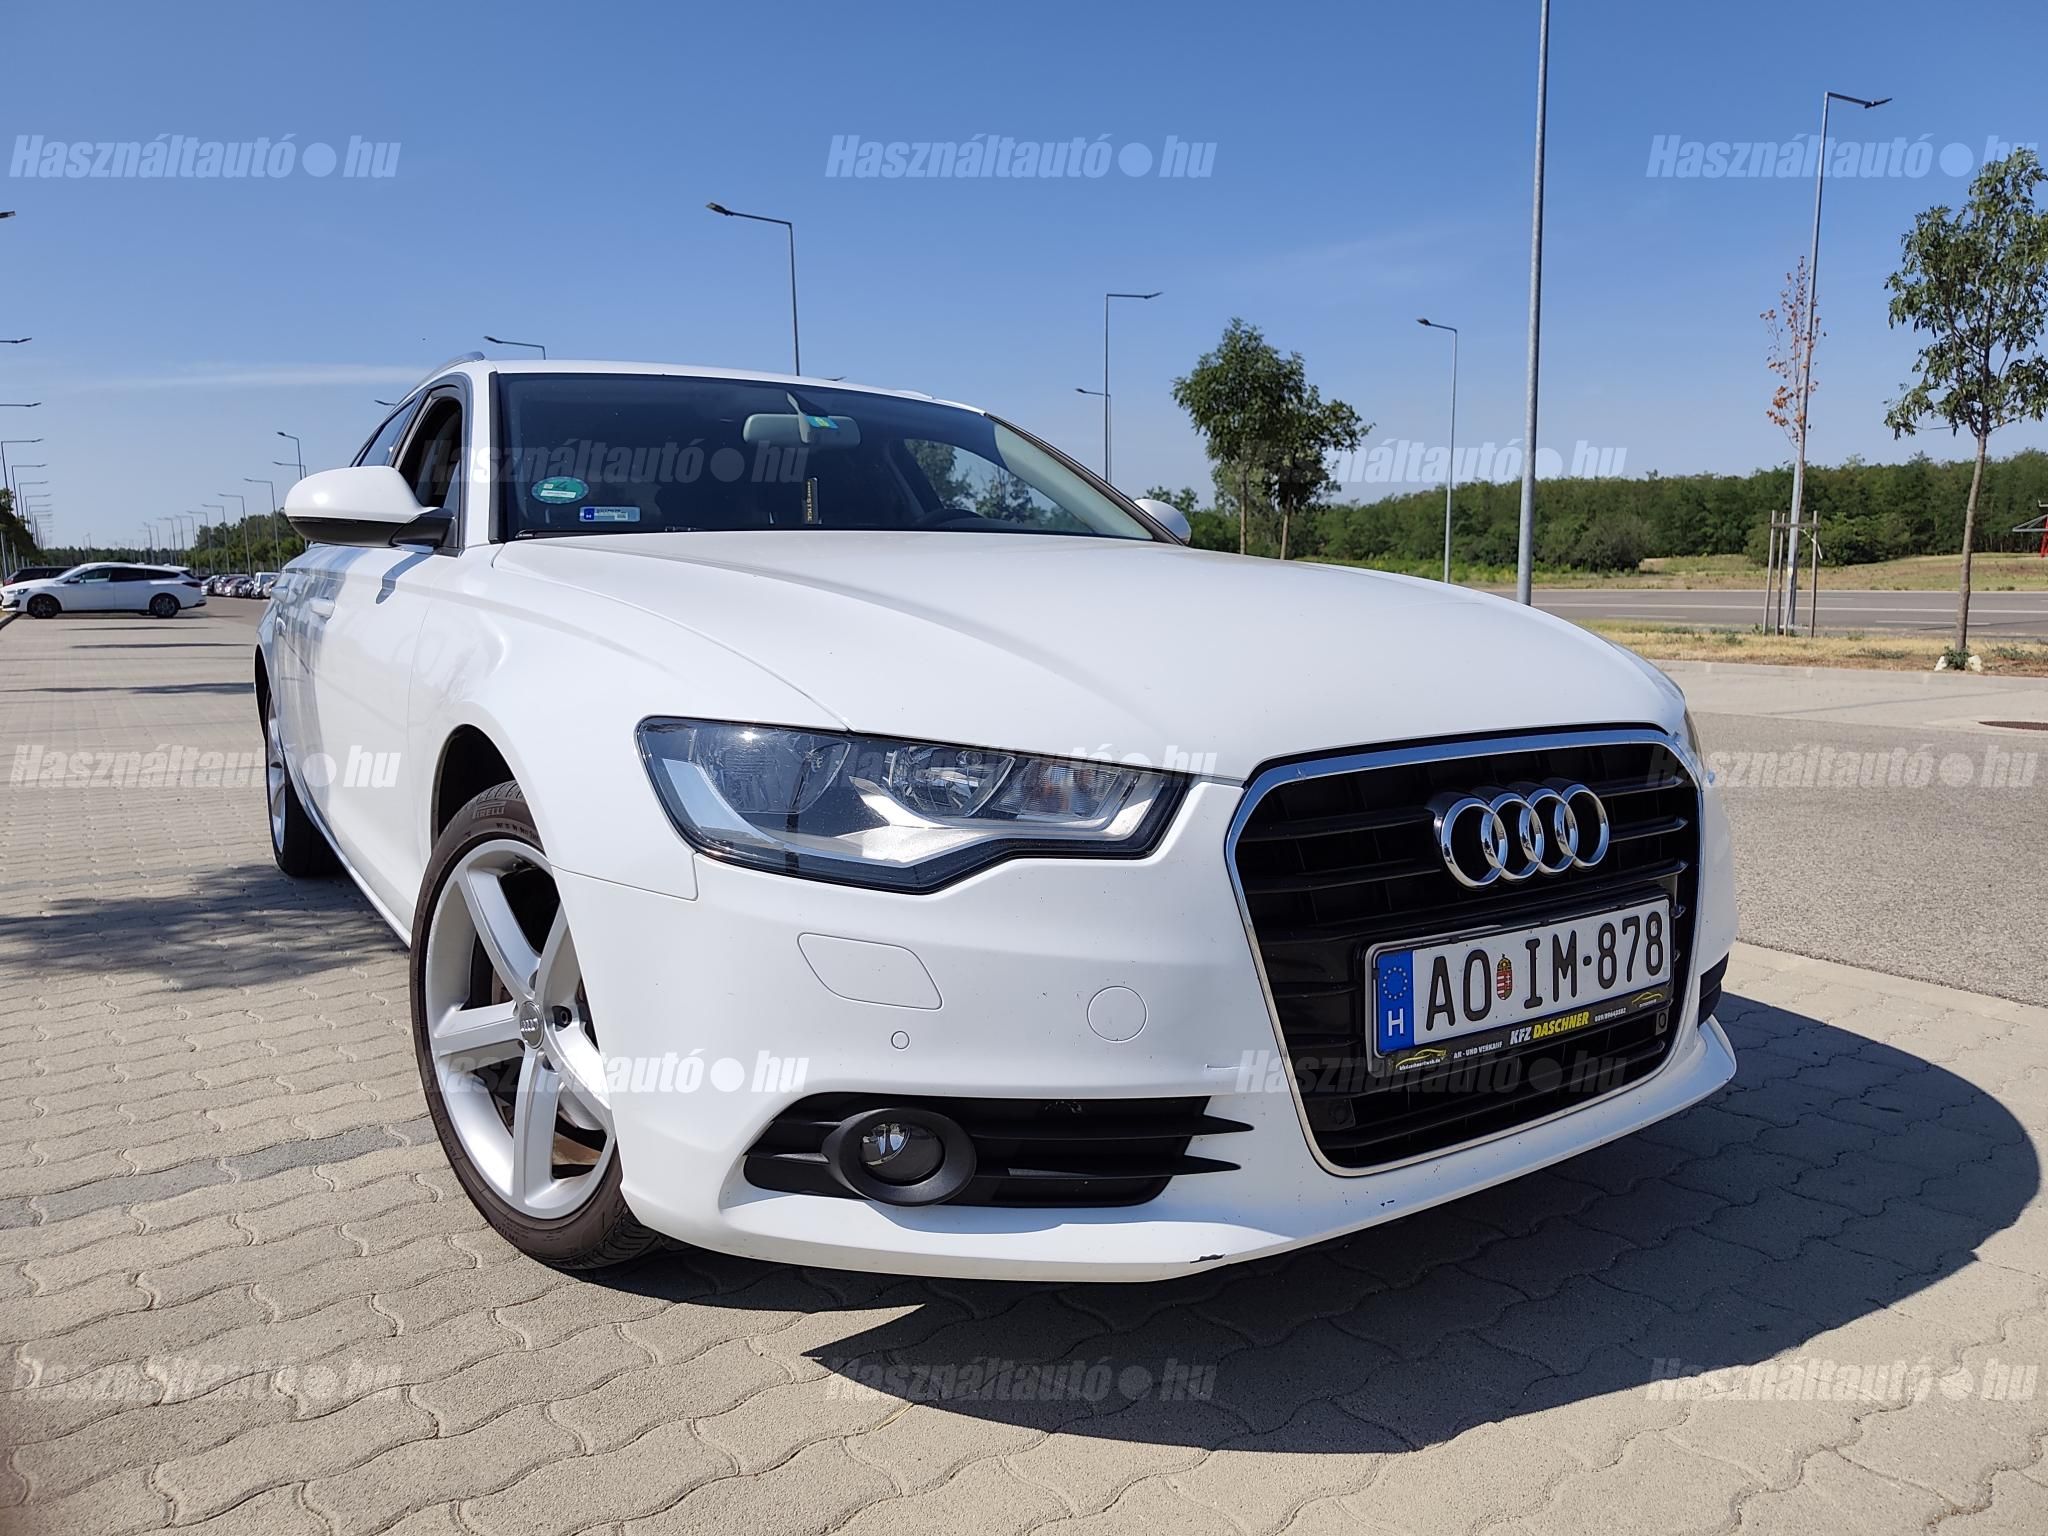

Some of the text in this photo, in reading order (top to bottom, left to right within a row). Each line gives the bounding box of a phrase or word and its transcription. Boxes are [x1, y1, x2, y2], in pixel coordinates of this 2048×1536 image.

[1426, 949, 1492, 1031] AO
[1387, 1007, 1405, 1037] H
[1509, 1011, 1590, 1046] KFZ DASCHNER
